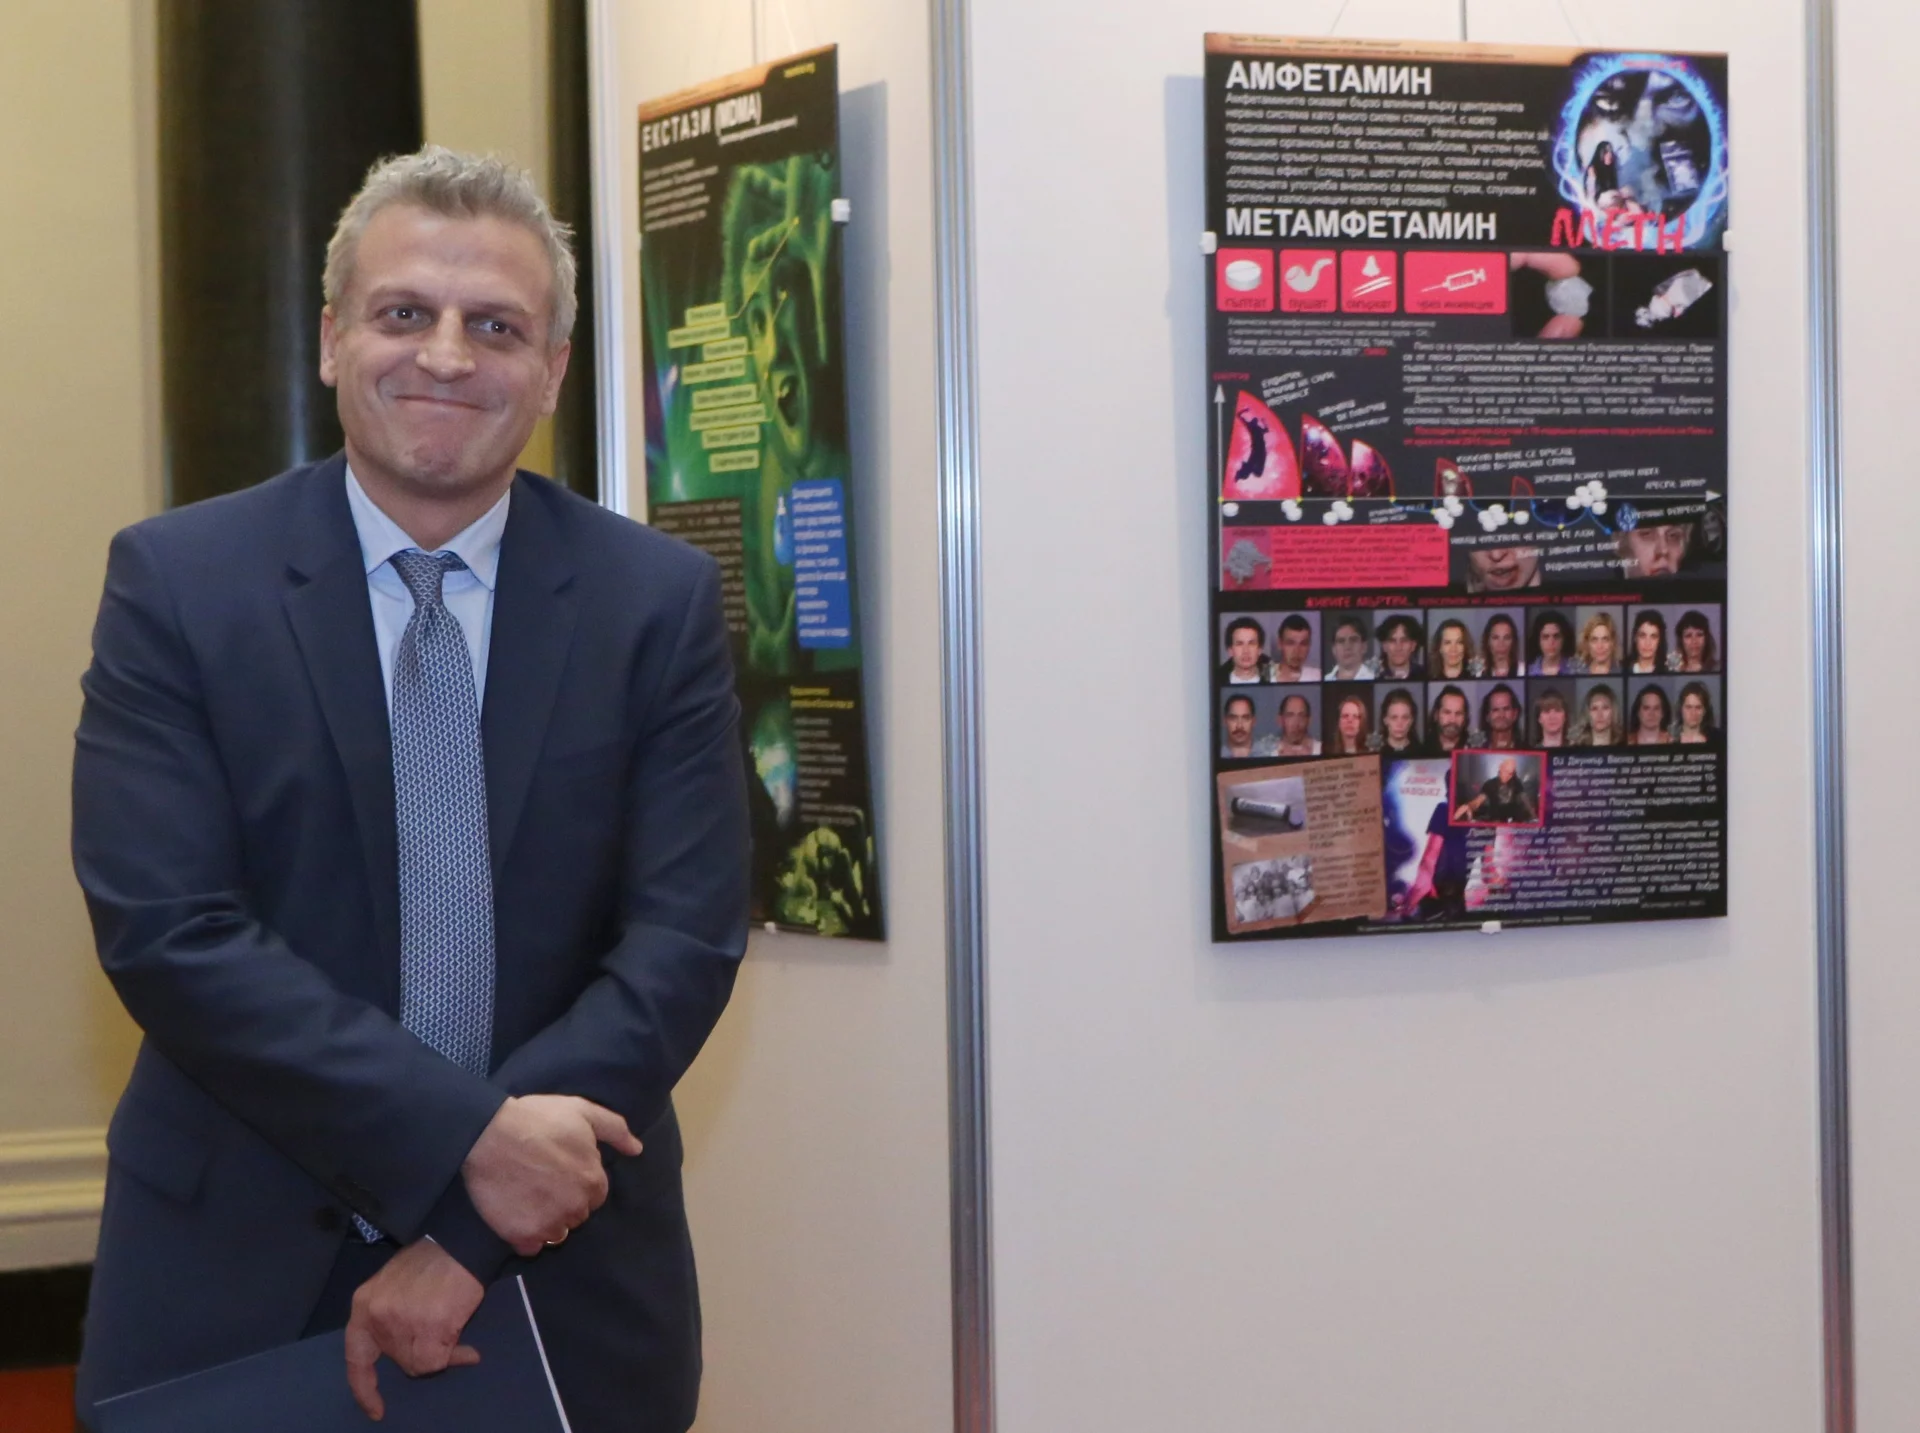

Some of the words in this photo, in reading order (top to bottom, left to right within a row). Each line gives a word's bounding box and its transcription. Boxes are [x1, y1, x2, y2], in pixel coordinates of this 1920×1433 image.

[1226, 61, 1432, 94] АМФЕТАМИН
[642, 107, 711, 151] ЕКСТАЗИ
[1226, 208, 1496, 240] МЕТАМФЕТАМИН
[1551, 208, 1687, 254] METH
